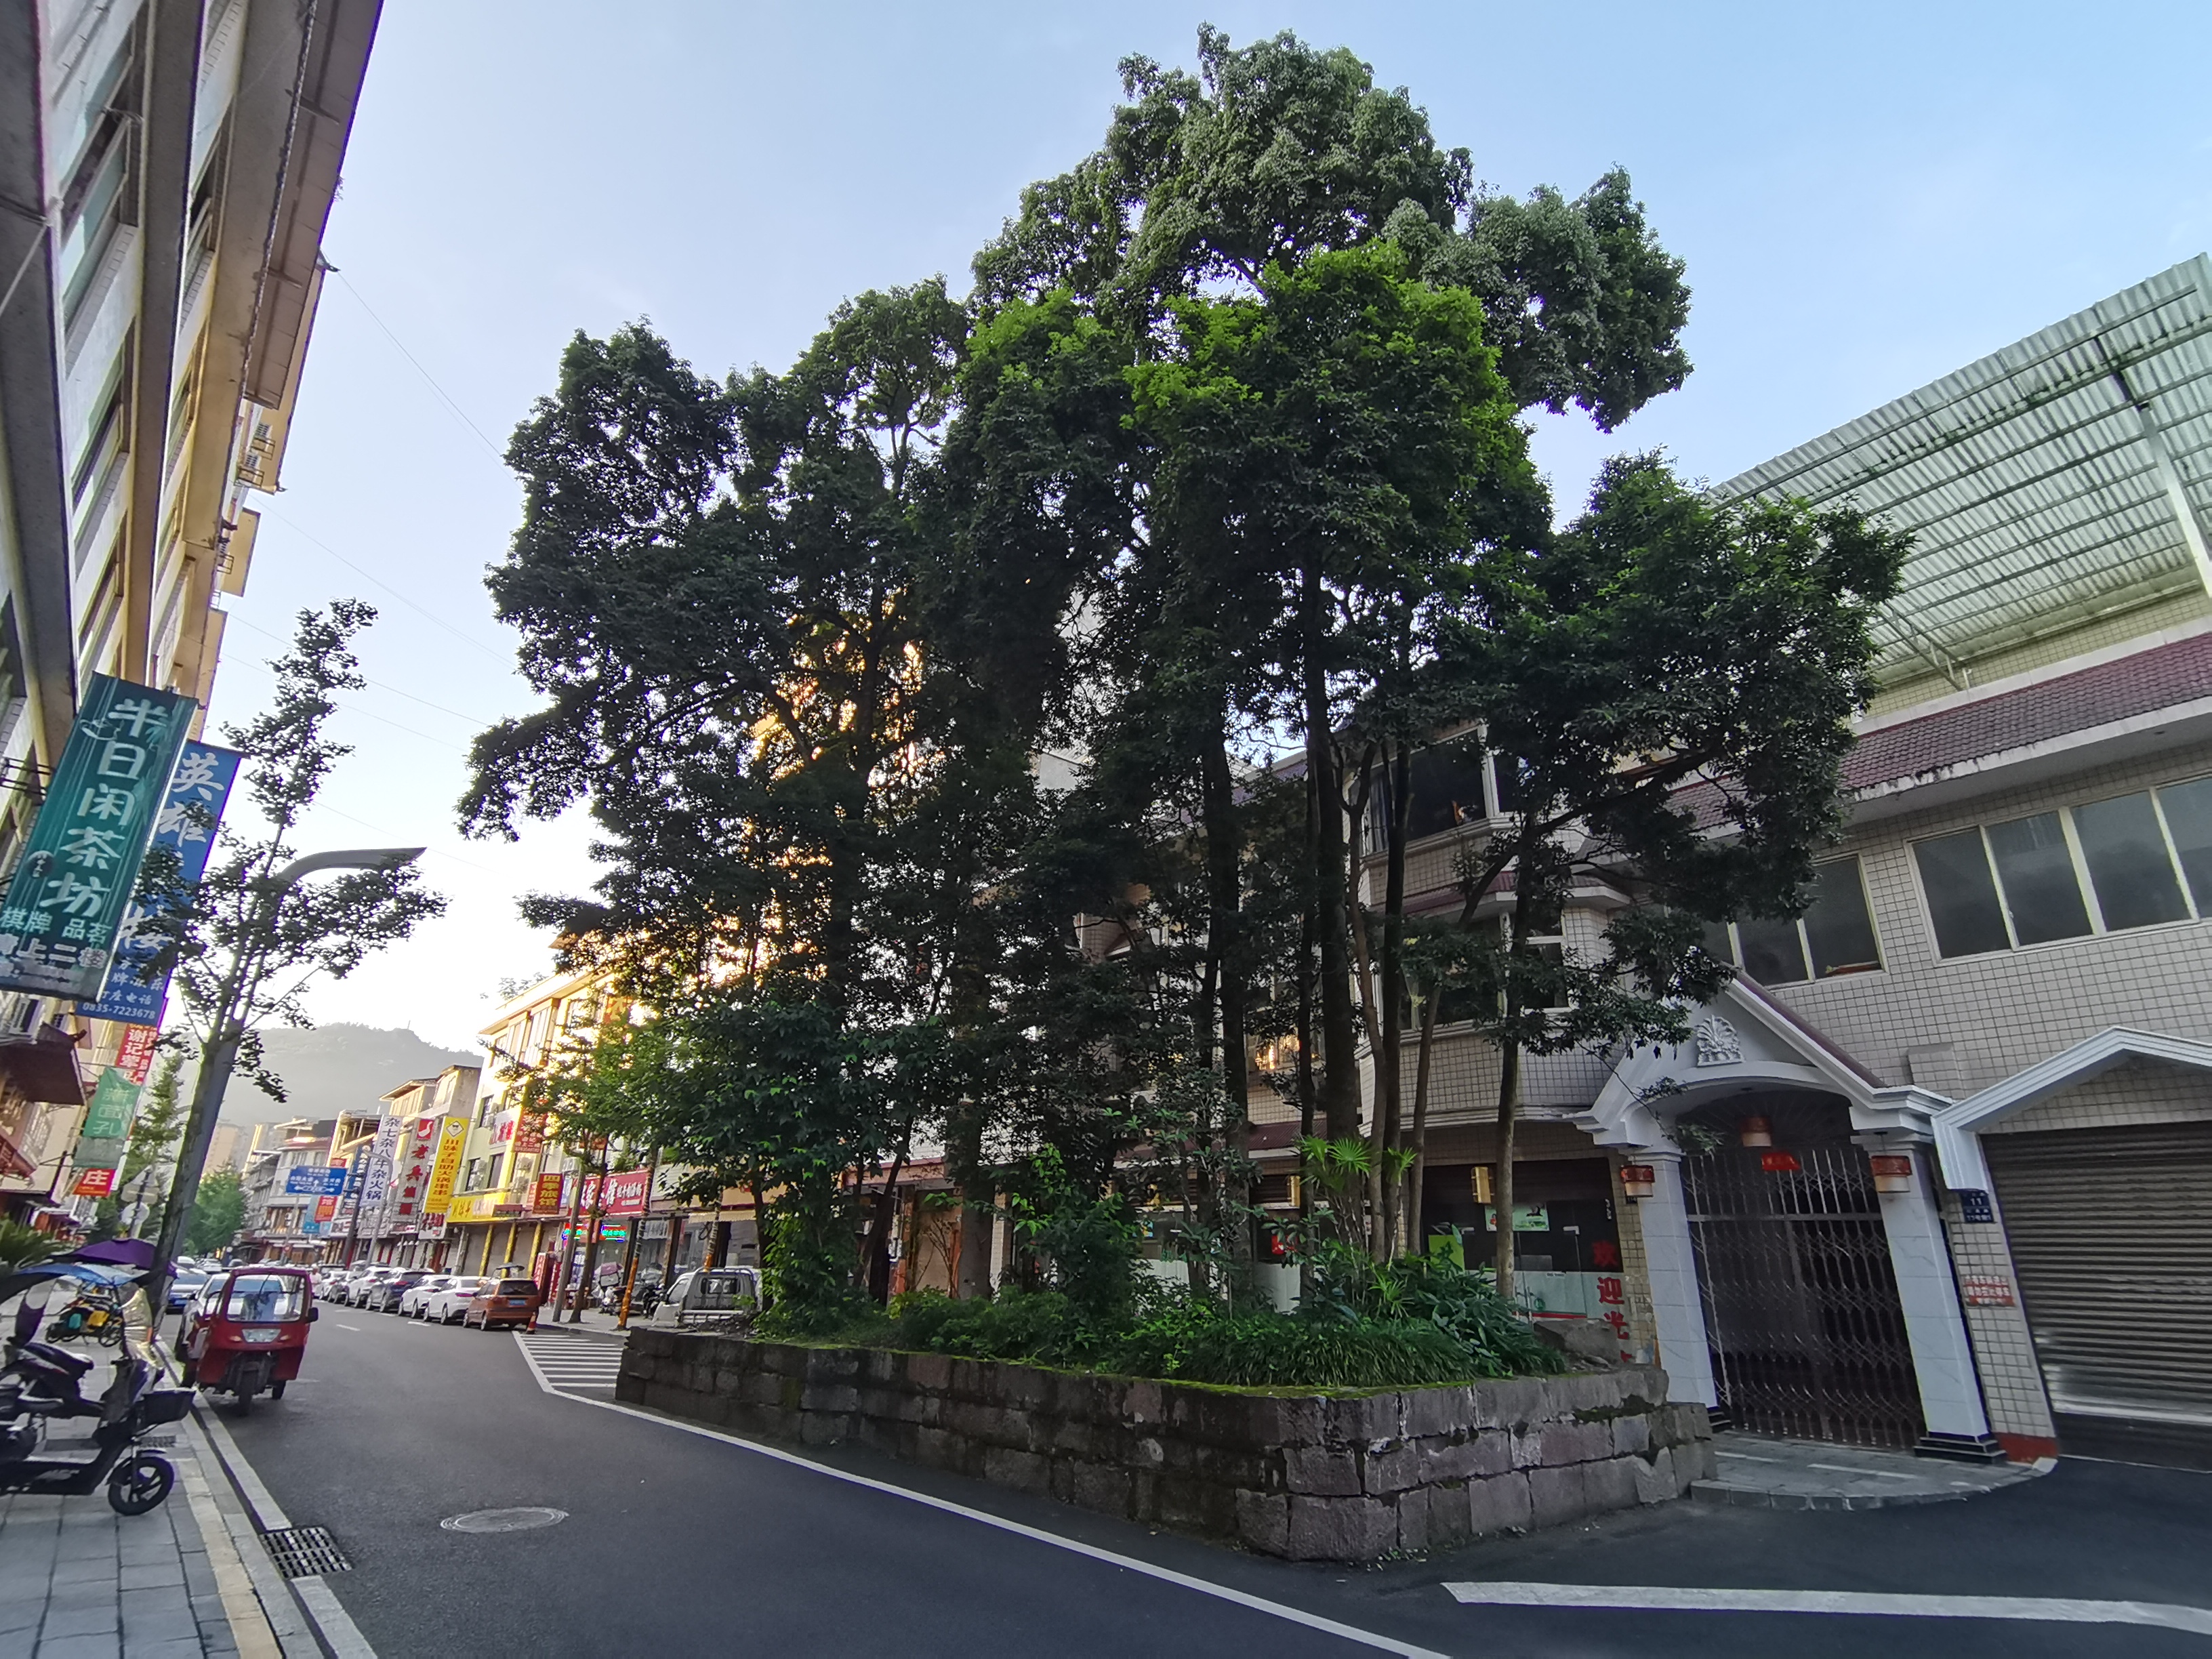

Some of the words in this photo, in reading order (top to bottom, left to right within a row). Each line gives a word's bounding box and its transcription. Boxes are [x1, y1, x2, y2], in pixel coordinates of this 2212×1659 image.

[39, 698, 169, 918] 半日闲茶坊
[0, 906, 53, 935] 棋牌
[62, 917, 112, 944] 品茗
[1592, 1240, 1633, 1363] 欢迎光
